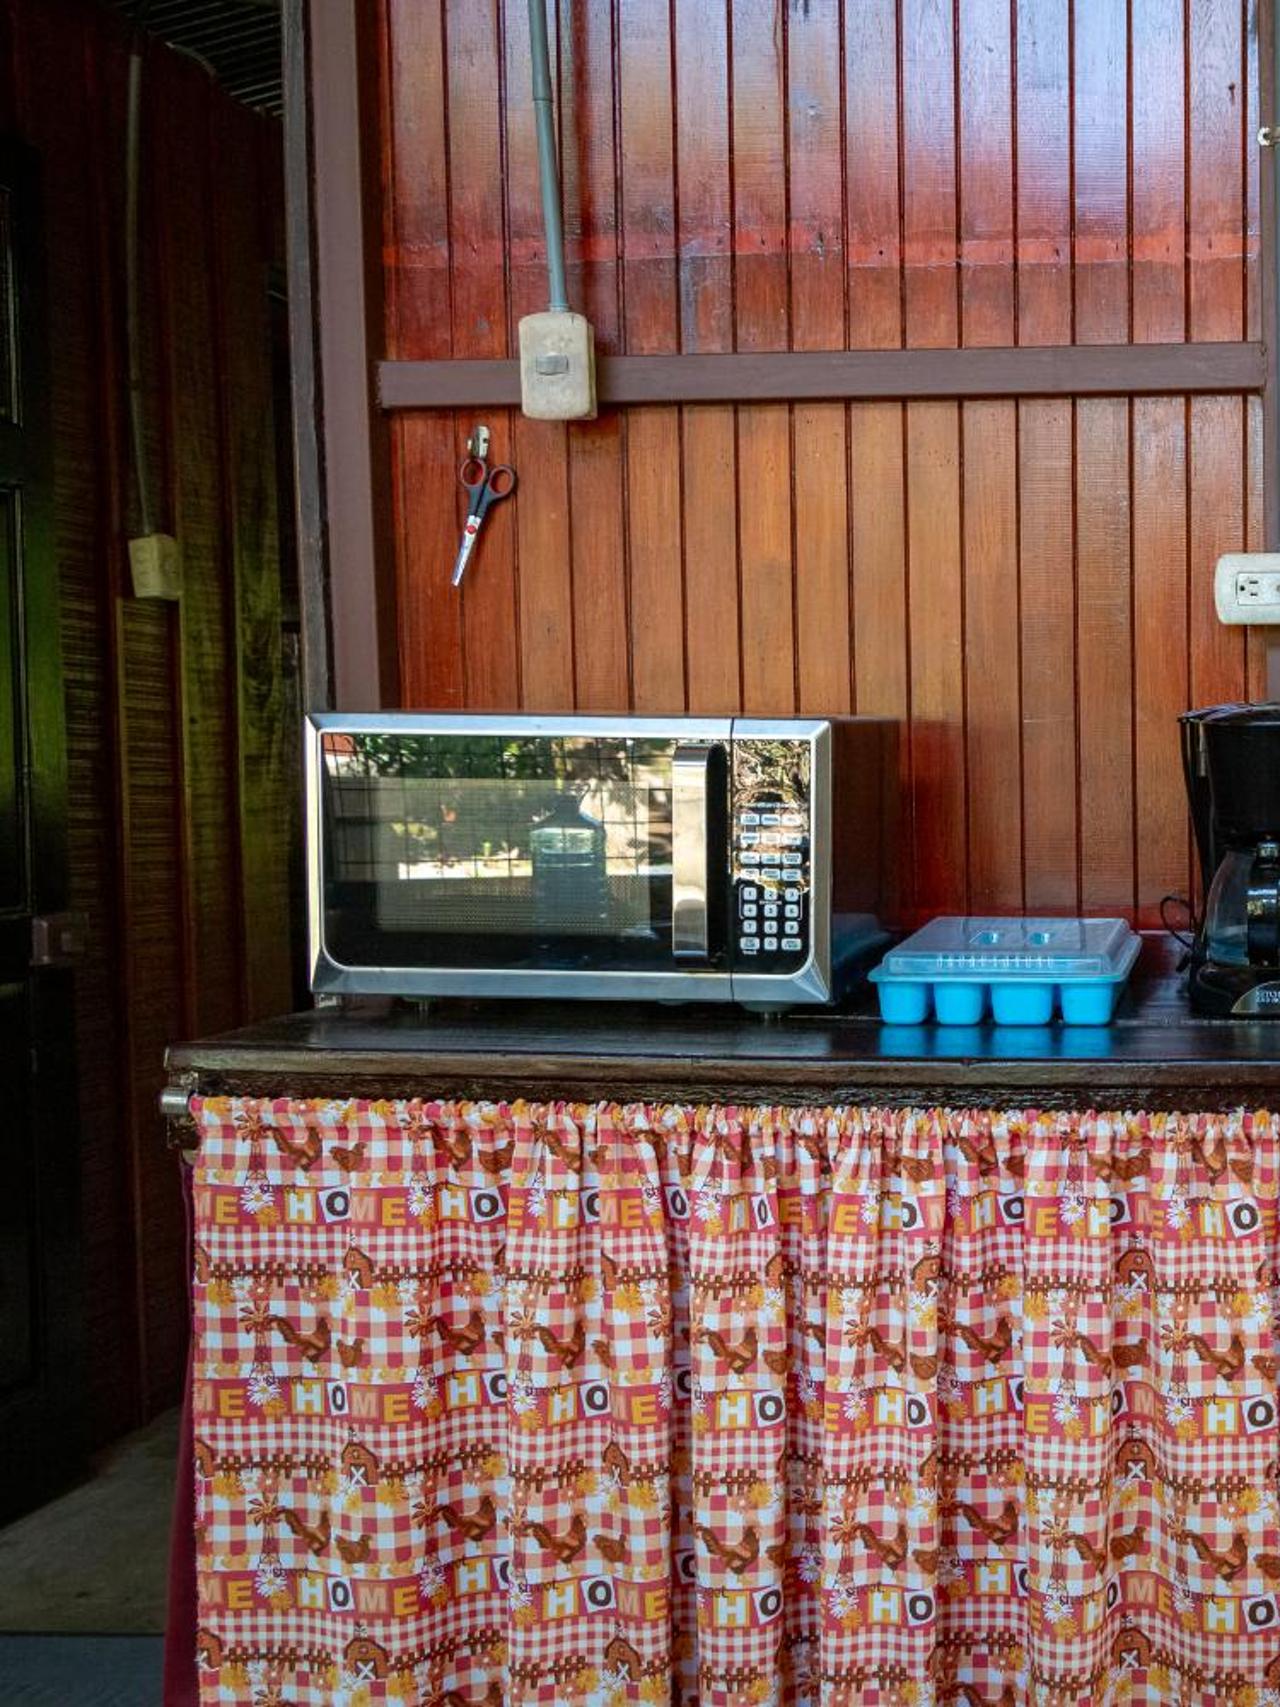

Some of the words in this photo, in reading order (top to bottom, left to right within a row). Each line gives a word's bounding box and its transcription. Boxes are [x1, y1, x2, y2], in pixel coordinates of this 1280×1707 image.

[290, 1190, 405, 1226] HOME
[296, 1380, 411, 1424] HOME
[450, 1374, 507, 1408] HO
[551, 1384, 657, 1426] HOME
[719, 1389, 784, 1429] HO
[878, 1391, 926, 1428] HO
[1208, 1400, 1274, 1436] HO
[301, 1574, 419, 1616] HOME
[550, 1580, 668, 1621] HOME
[719, 1589, 782, 1628] HO
[872, 1588, 933, 1622] HO
[1208, 1599, 1276, 1634] HO
